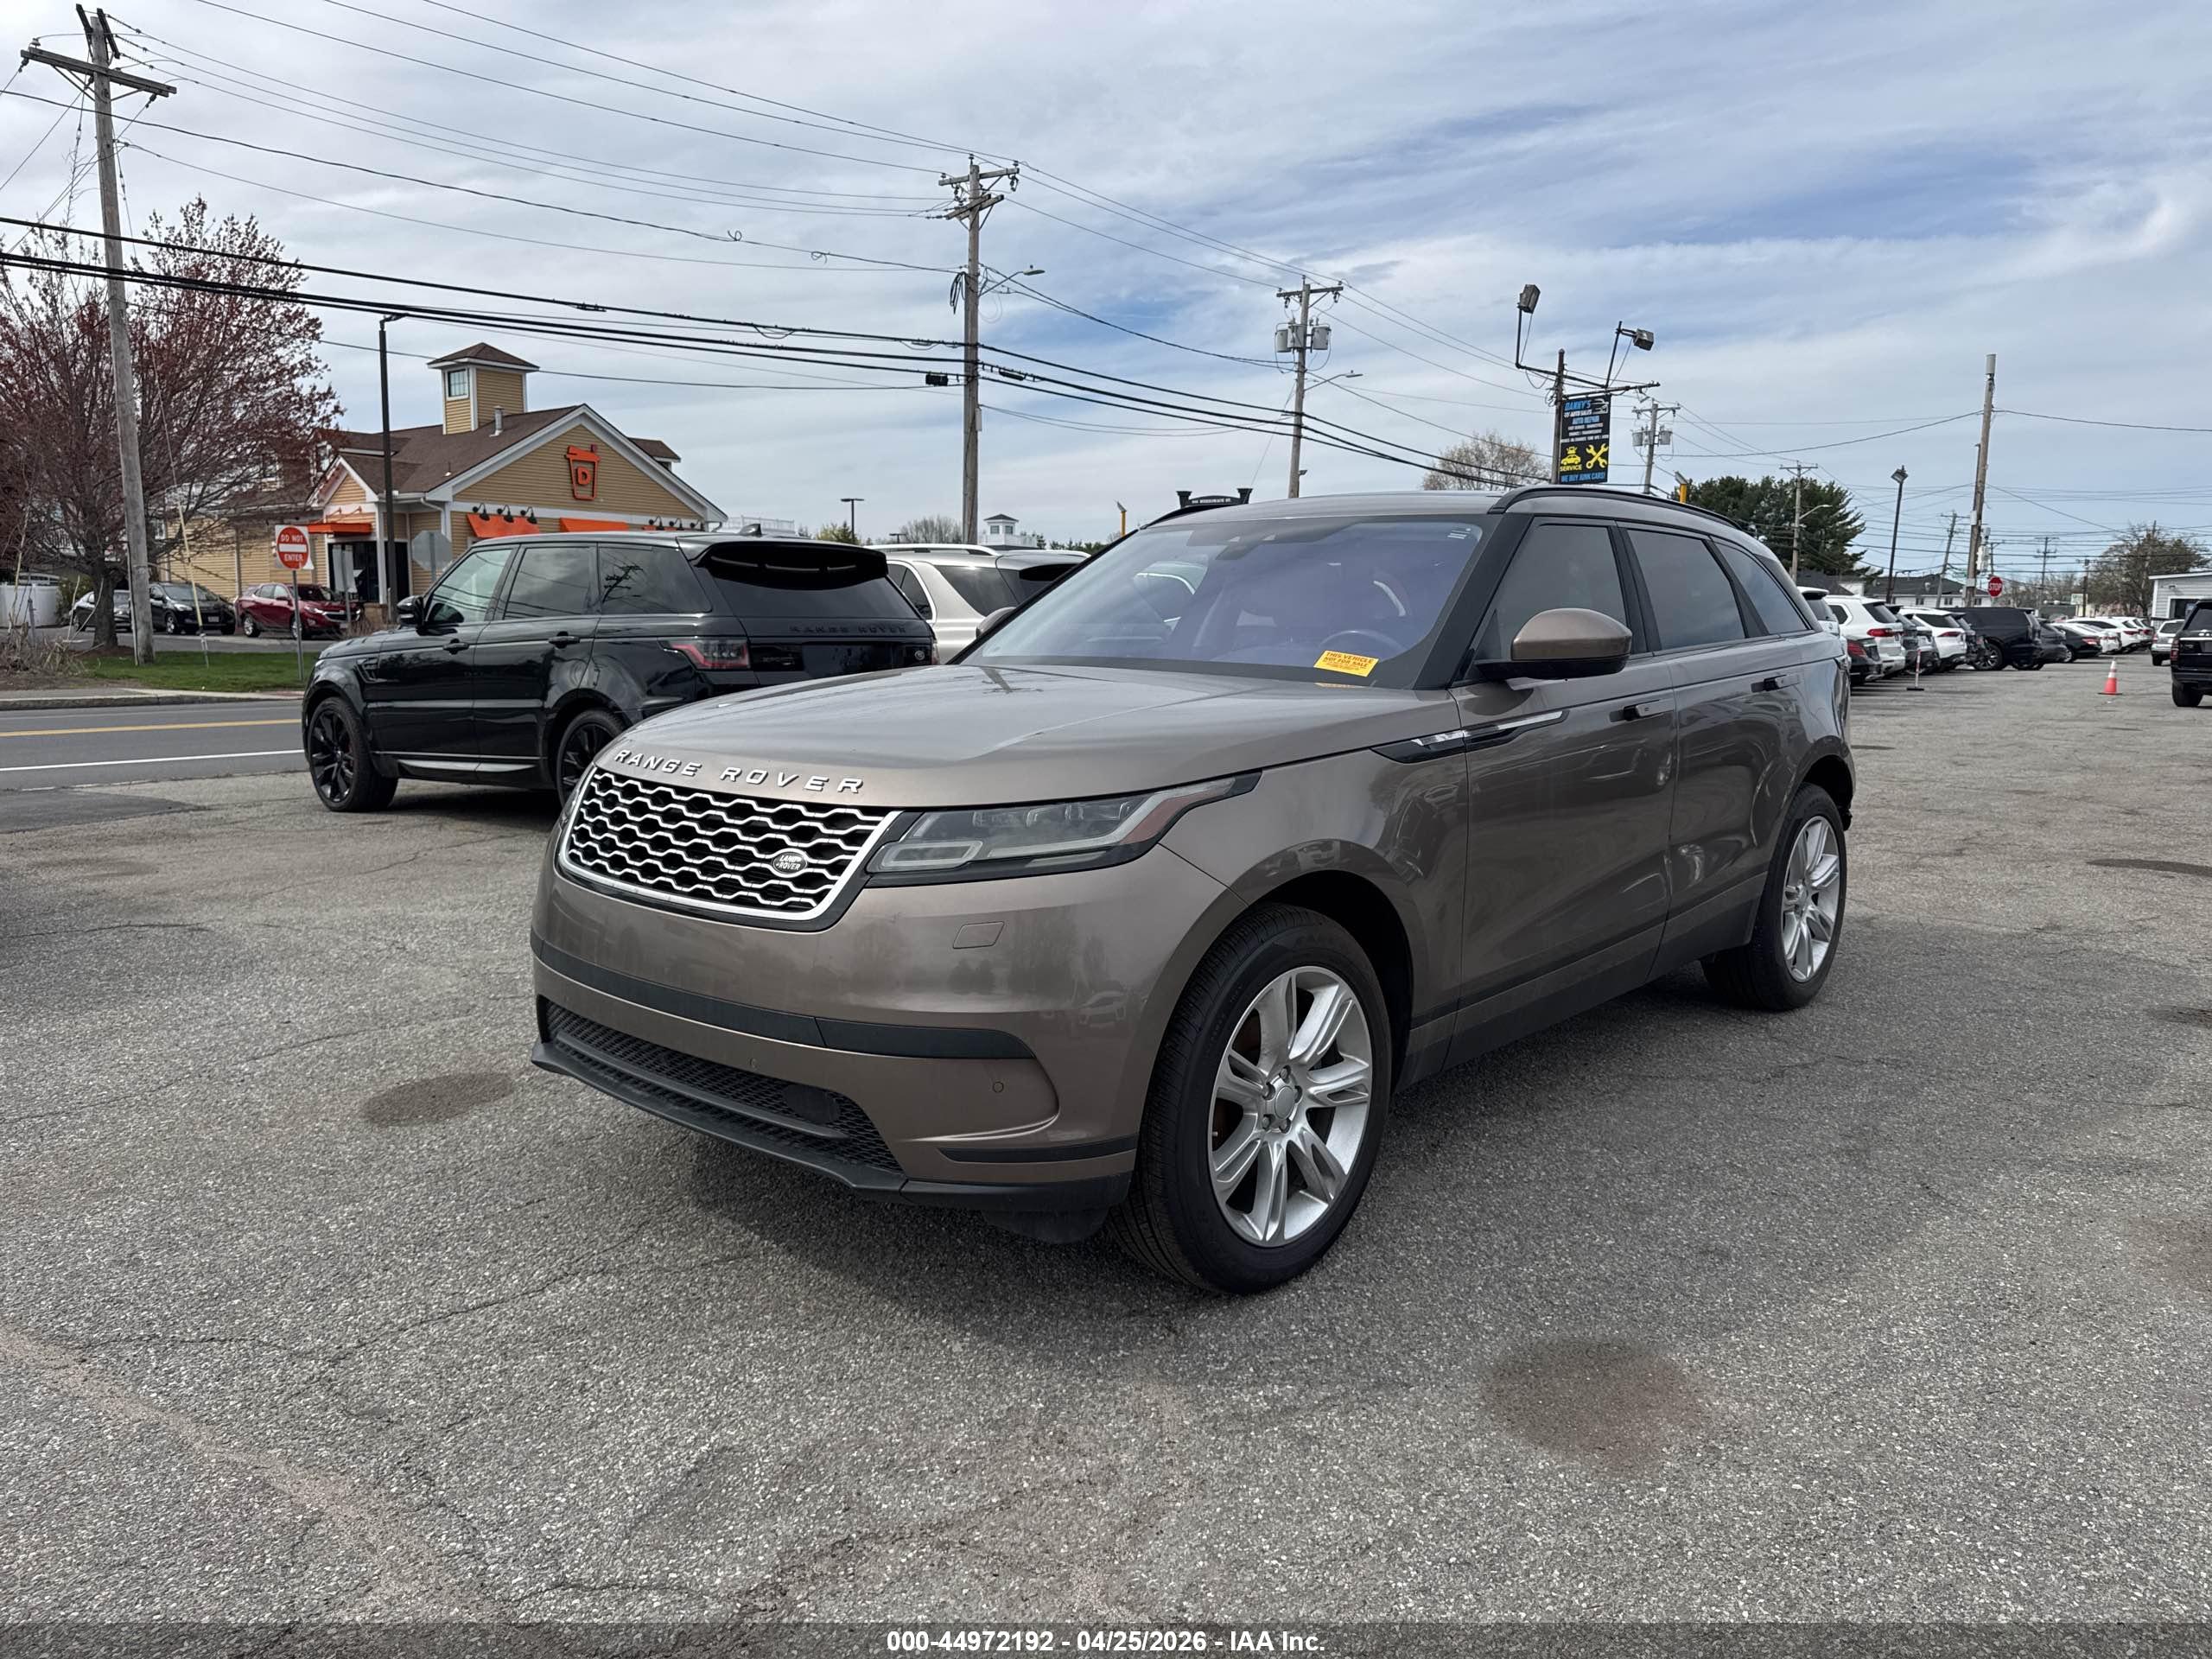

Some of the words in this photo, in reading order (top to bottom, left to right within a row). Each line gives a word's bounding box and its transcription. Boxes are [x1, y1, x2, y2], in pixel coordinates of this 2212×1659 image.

[577, 466, 592, 485] D
[284, 553, 303, 562] ENTER
[1989, 582, 2002, 591] STOP
[1344, 655, 1374, 664] VEHICLE
[614, 749, 702, 777] RANGE
[720, 766, 864, 793] ROVER
[779, 861, 801, 871] ROVER
